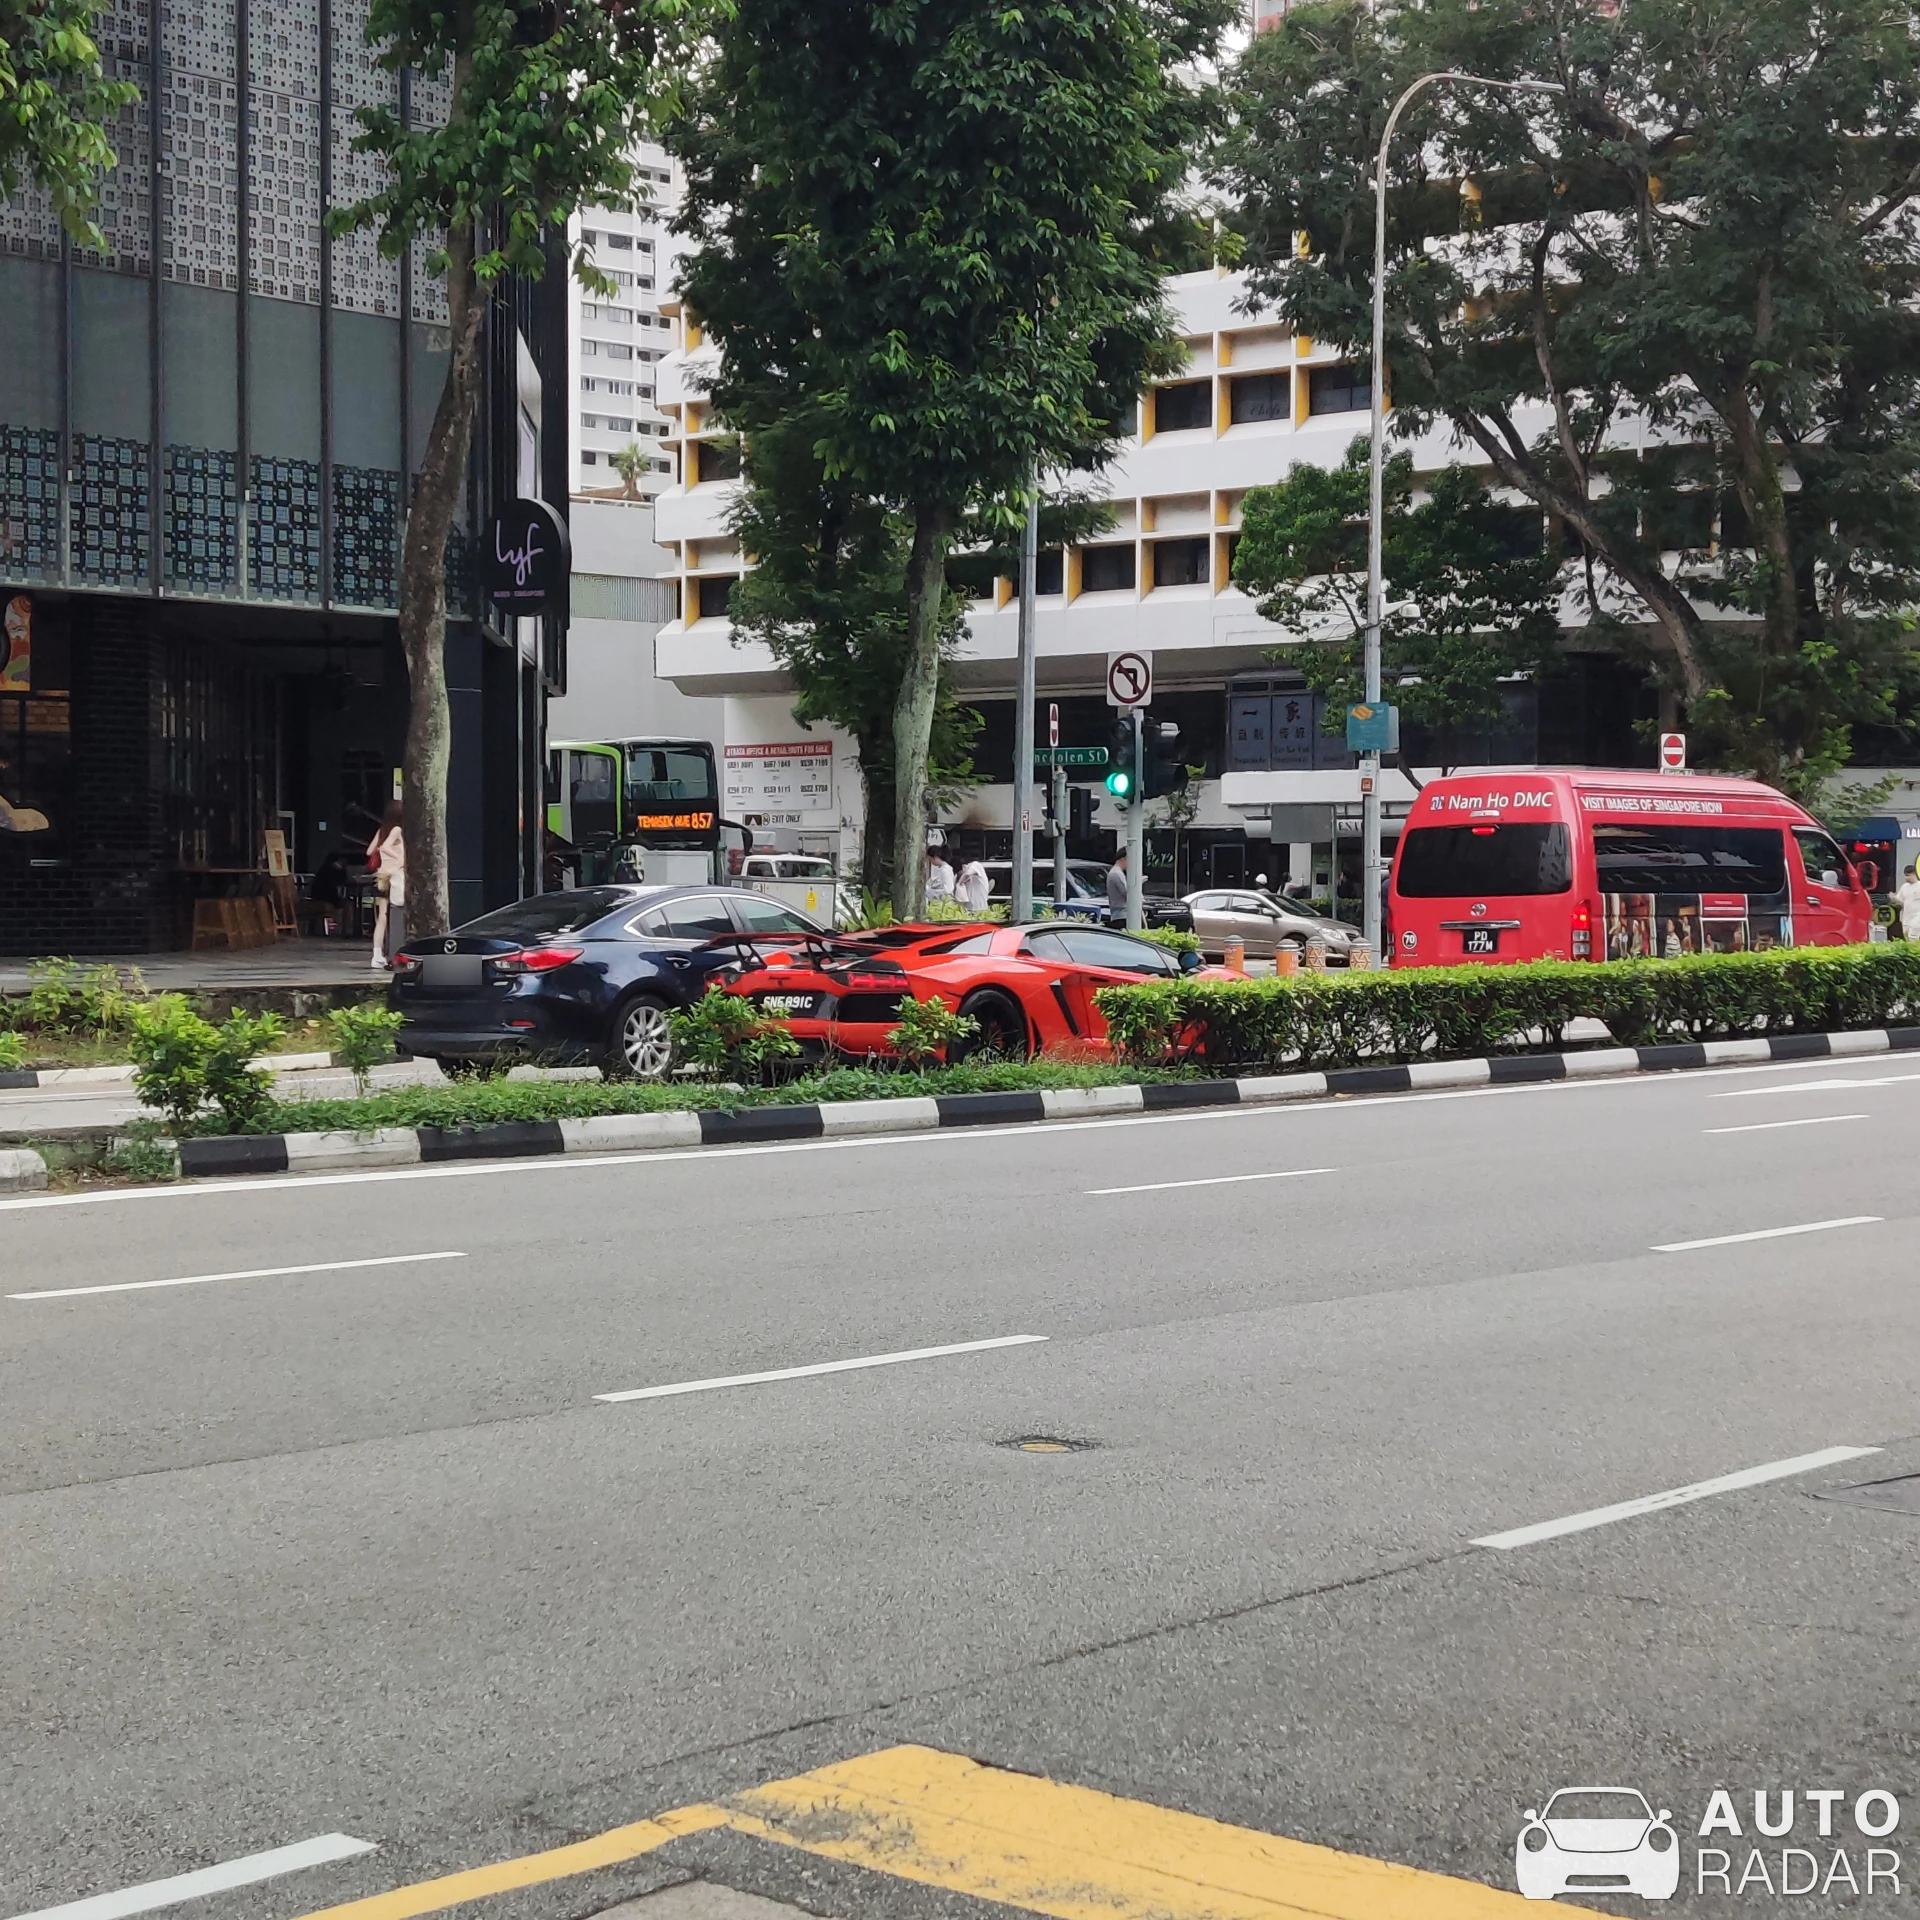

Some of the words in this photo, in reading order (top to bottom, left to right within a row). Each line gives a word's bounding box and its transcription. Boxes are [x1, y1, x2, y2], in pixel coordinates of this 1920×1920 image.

[496, 520, 544, 586] lyf
[1034, 750, 1083, 762] ncolen
[1088, 750, 1101, 762] St
[1448, 793, 1482, 810] Nam
[1487, 792, 1509, 807] Ho
[1513, 792, 1554, 807] DMC
[1580, 796, 1605, 809] VISIT
[1606, 797, 1639, 811] IMAGES
[1640, 799, 1653, 811] OF
[1653, 799, 1701, 813] SINGAPORE
[1702, 801, 1723, 814] NOW
[637, 815, 674, 828] TEMASEK
[691, 812, 713, 829] 857
[771, 814, 785, 823] EXIT
[1404, 934, 1415, 944] 70
[1474, 931, 1488, 941] PD
[1467, 941, 1493, 951] 177M
